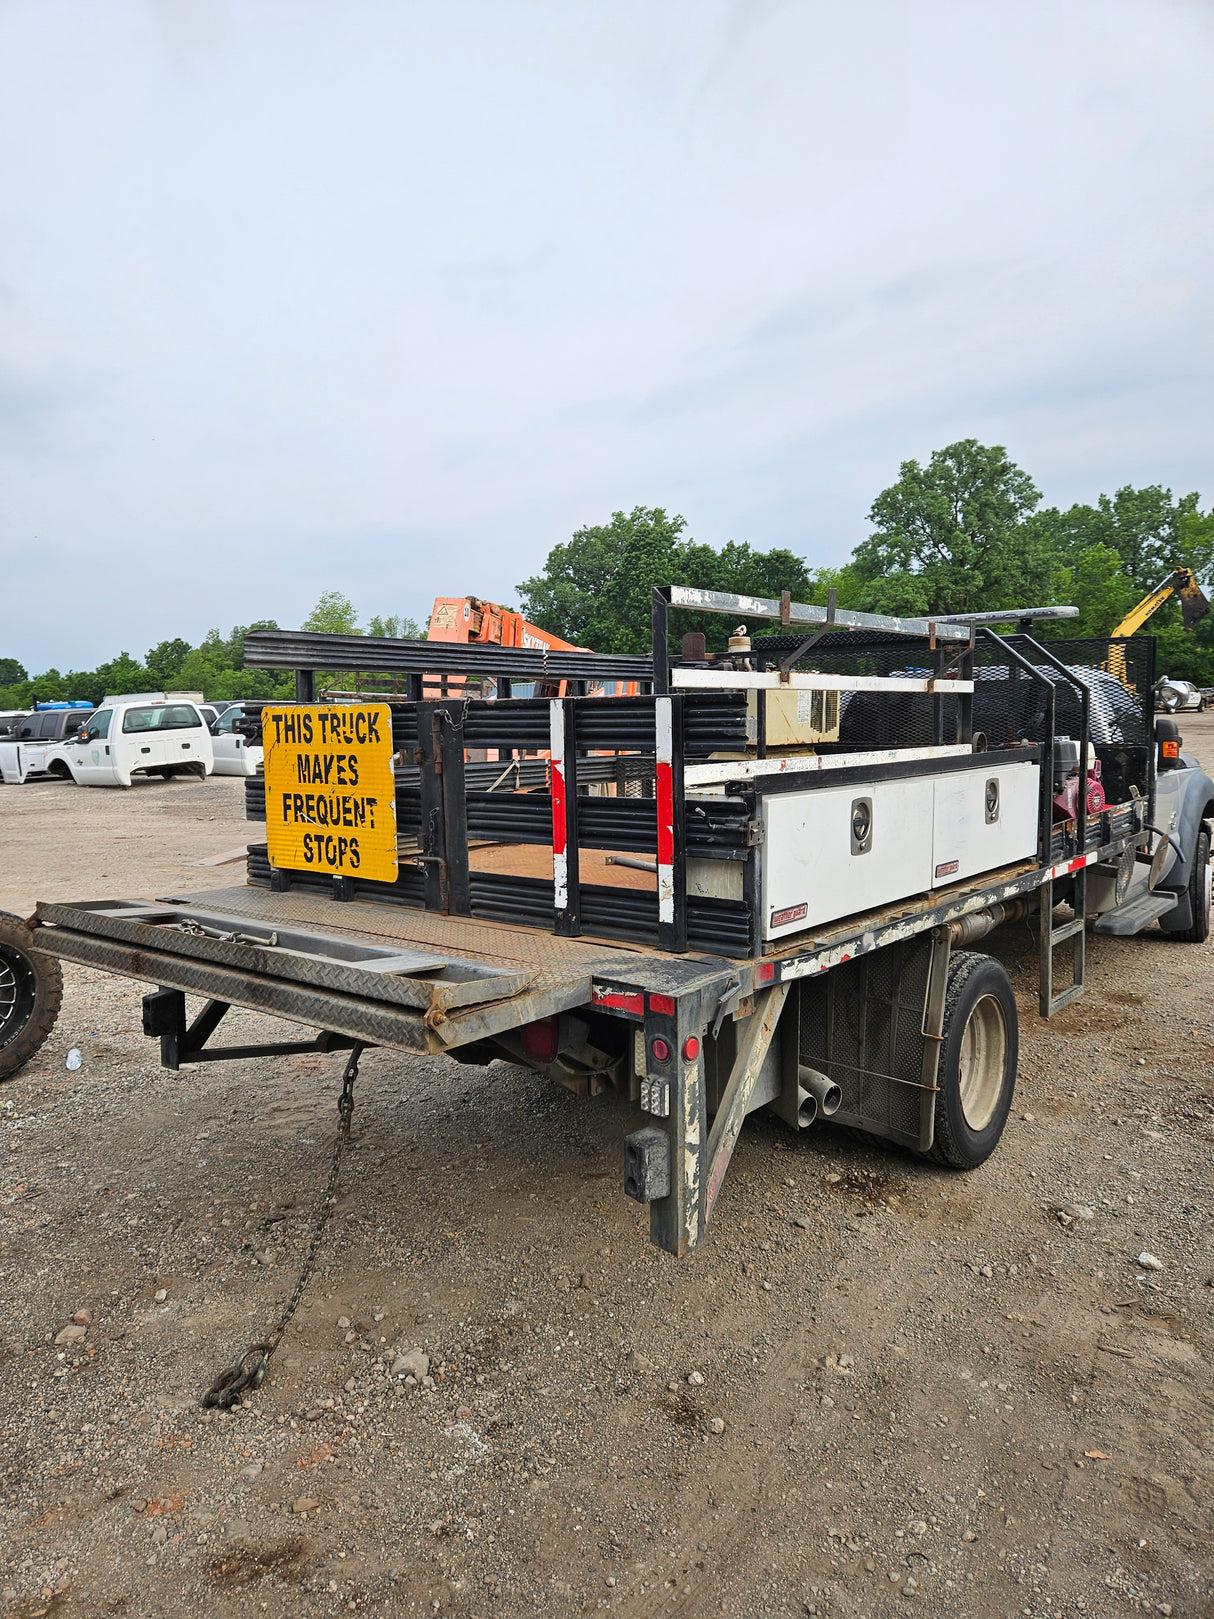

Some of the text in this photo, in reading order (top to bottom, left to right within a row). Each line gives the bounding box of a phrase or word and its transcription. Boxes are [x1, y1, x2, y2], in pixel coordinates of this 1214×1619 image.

[272, 712, 381, 744] THIS TRUCK
[297, 754, 359, 786] MAKES
[282, 793, 378, 829] FREQUENT
[303, 833, 361, 869] STOPS
